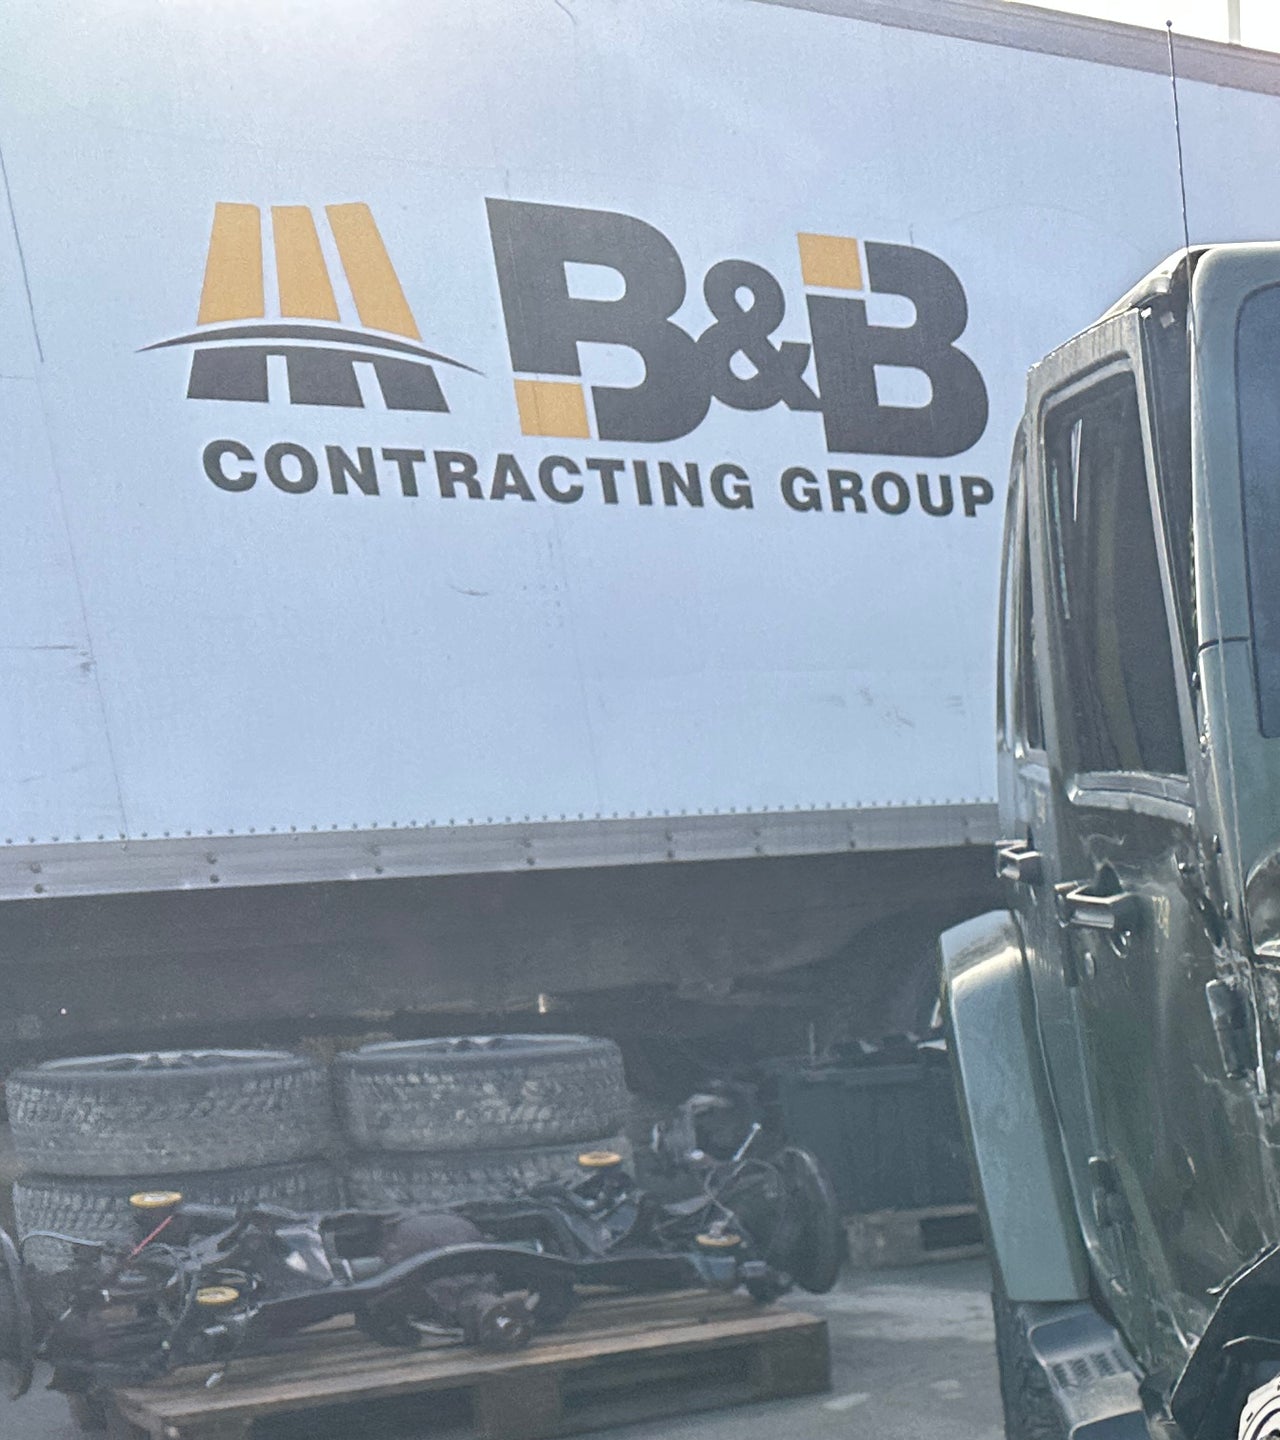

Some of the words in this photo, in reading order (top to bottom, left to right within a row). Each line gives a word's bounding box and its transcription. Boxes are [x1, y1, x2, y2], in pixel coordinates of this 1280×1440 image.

[485, 197, 989, 458] B&B
[201, 438, 754, 510] CONTRACTING
[780, 466, 995, 518] GROUP
